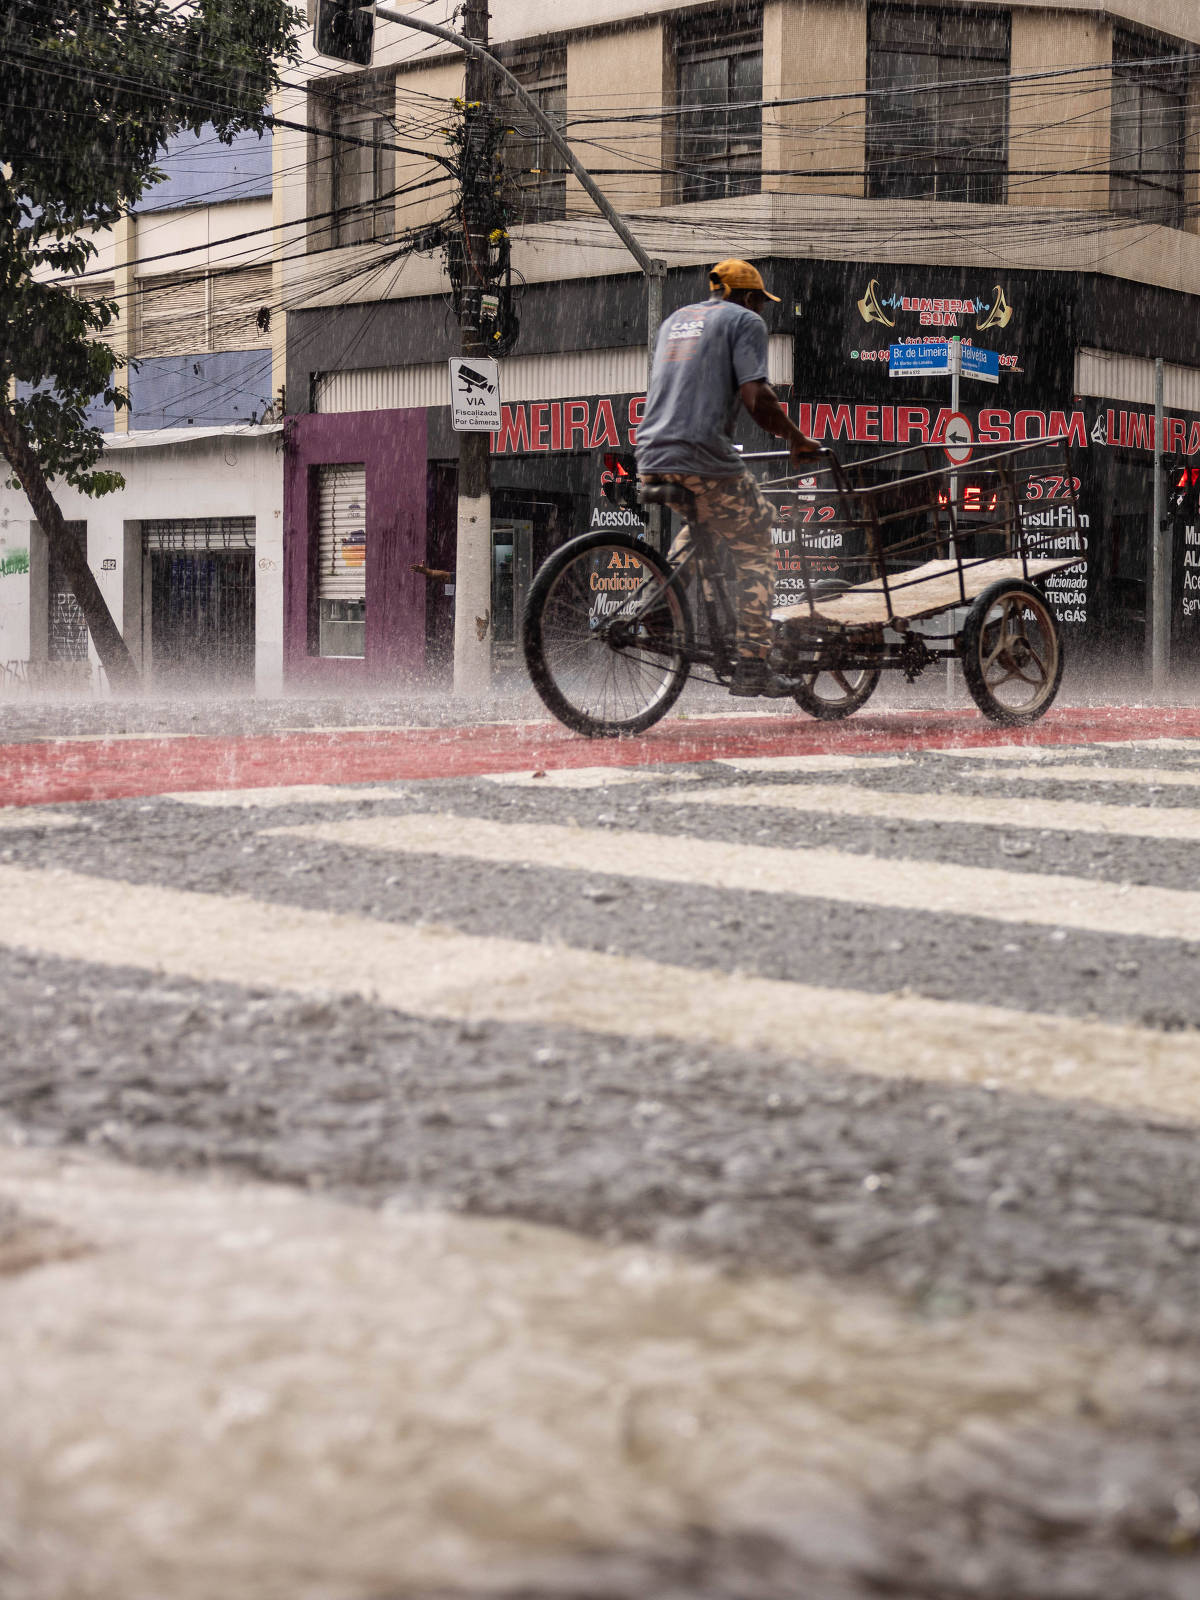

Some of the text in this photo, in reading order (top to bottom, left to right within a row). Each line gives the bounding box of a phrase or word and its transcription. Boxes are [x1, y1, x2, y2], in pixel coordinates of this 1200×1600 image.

[902, 298, 976, 314] LIMEIRA
[920, 312, 957, 327] SOM
[893, 347, 947, 358] Br. de Limeira
[466, 397, 486, 406] VIA
[469, 416, 499, 426] Câmeras
[490, 399, 621, 453] MEIRA
[775, 402, 1089, 448] IMEIRA SOM
[1026, 474, 1082, 501] 572
[591, 508, 645, 527] Acessóri
[770, 527, 843, 549] Mulimídia
[590, 572, 644, 591] Condicion
[1044, 573, 1088, 589] dicionado
[1044, 590, 1087, 605] TENÇÃO
[1064, 607, 1087, 623] GÁS
